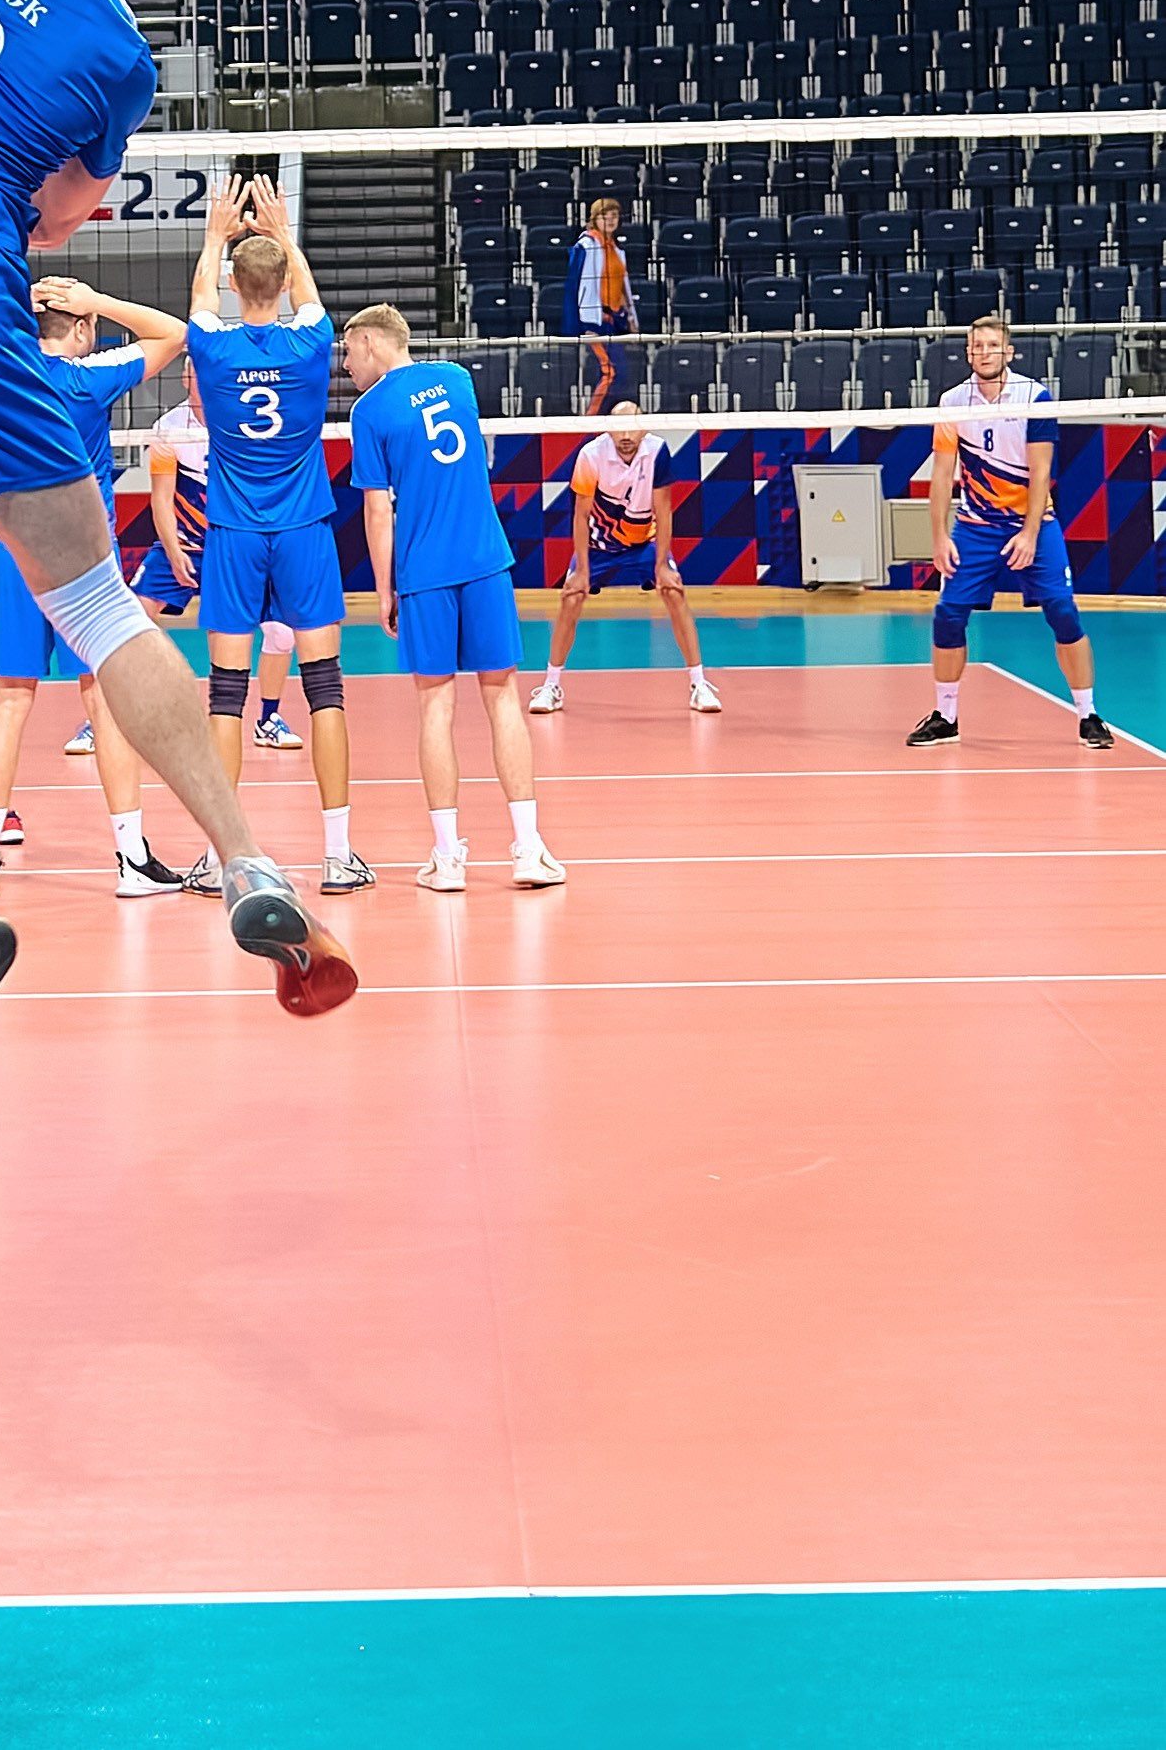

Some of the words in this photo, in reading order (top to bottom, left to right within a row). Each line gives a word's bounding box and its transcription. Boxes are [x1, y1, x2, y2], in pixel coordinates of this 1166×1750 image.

[239, 386, 283, 440] 3
[421, 400, 467, 465] 5
[983, 428, 994, 452] 8
